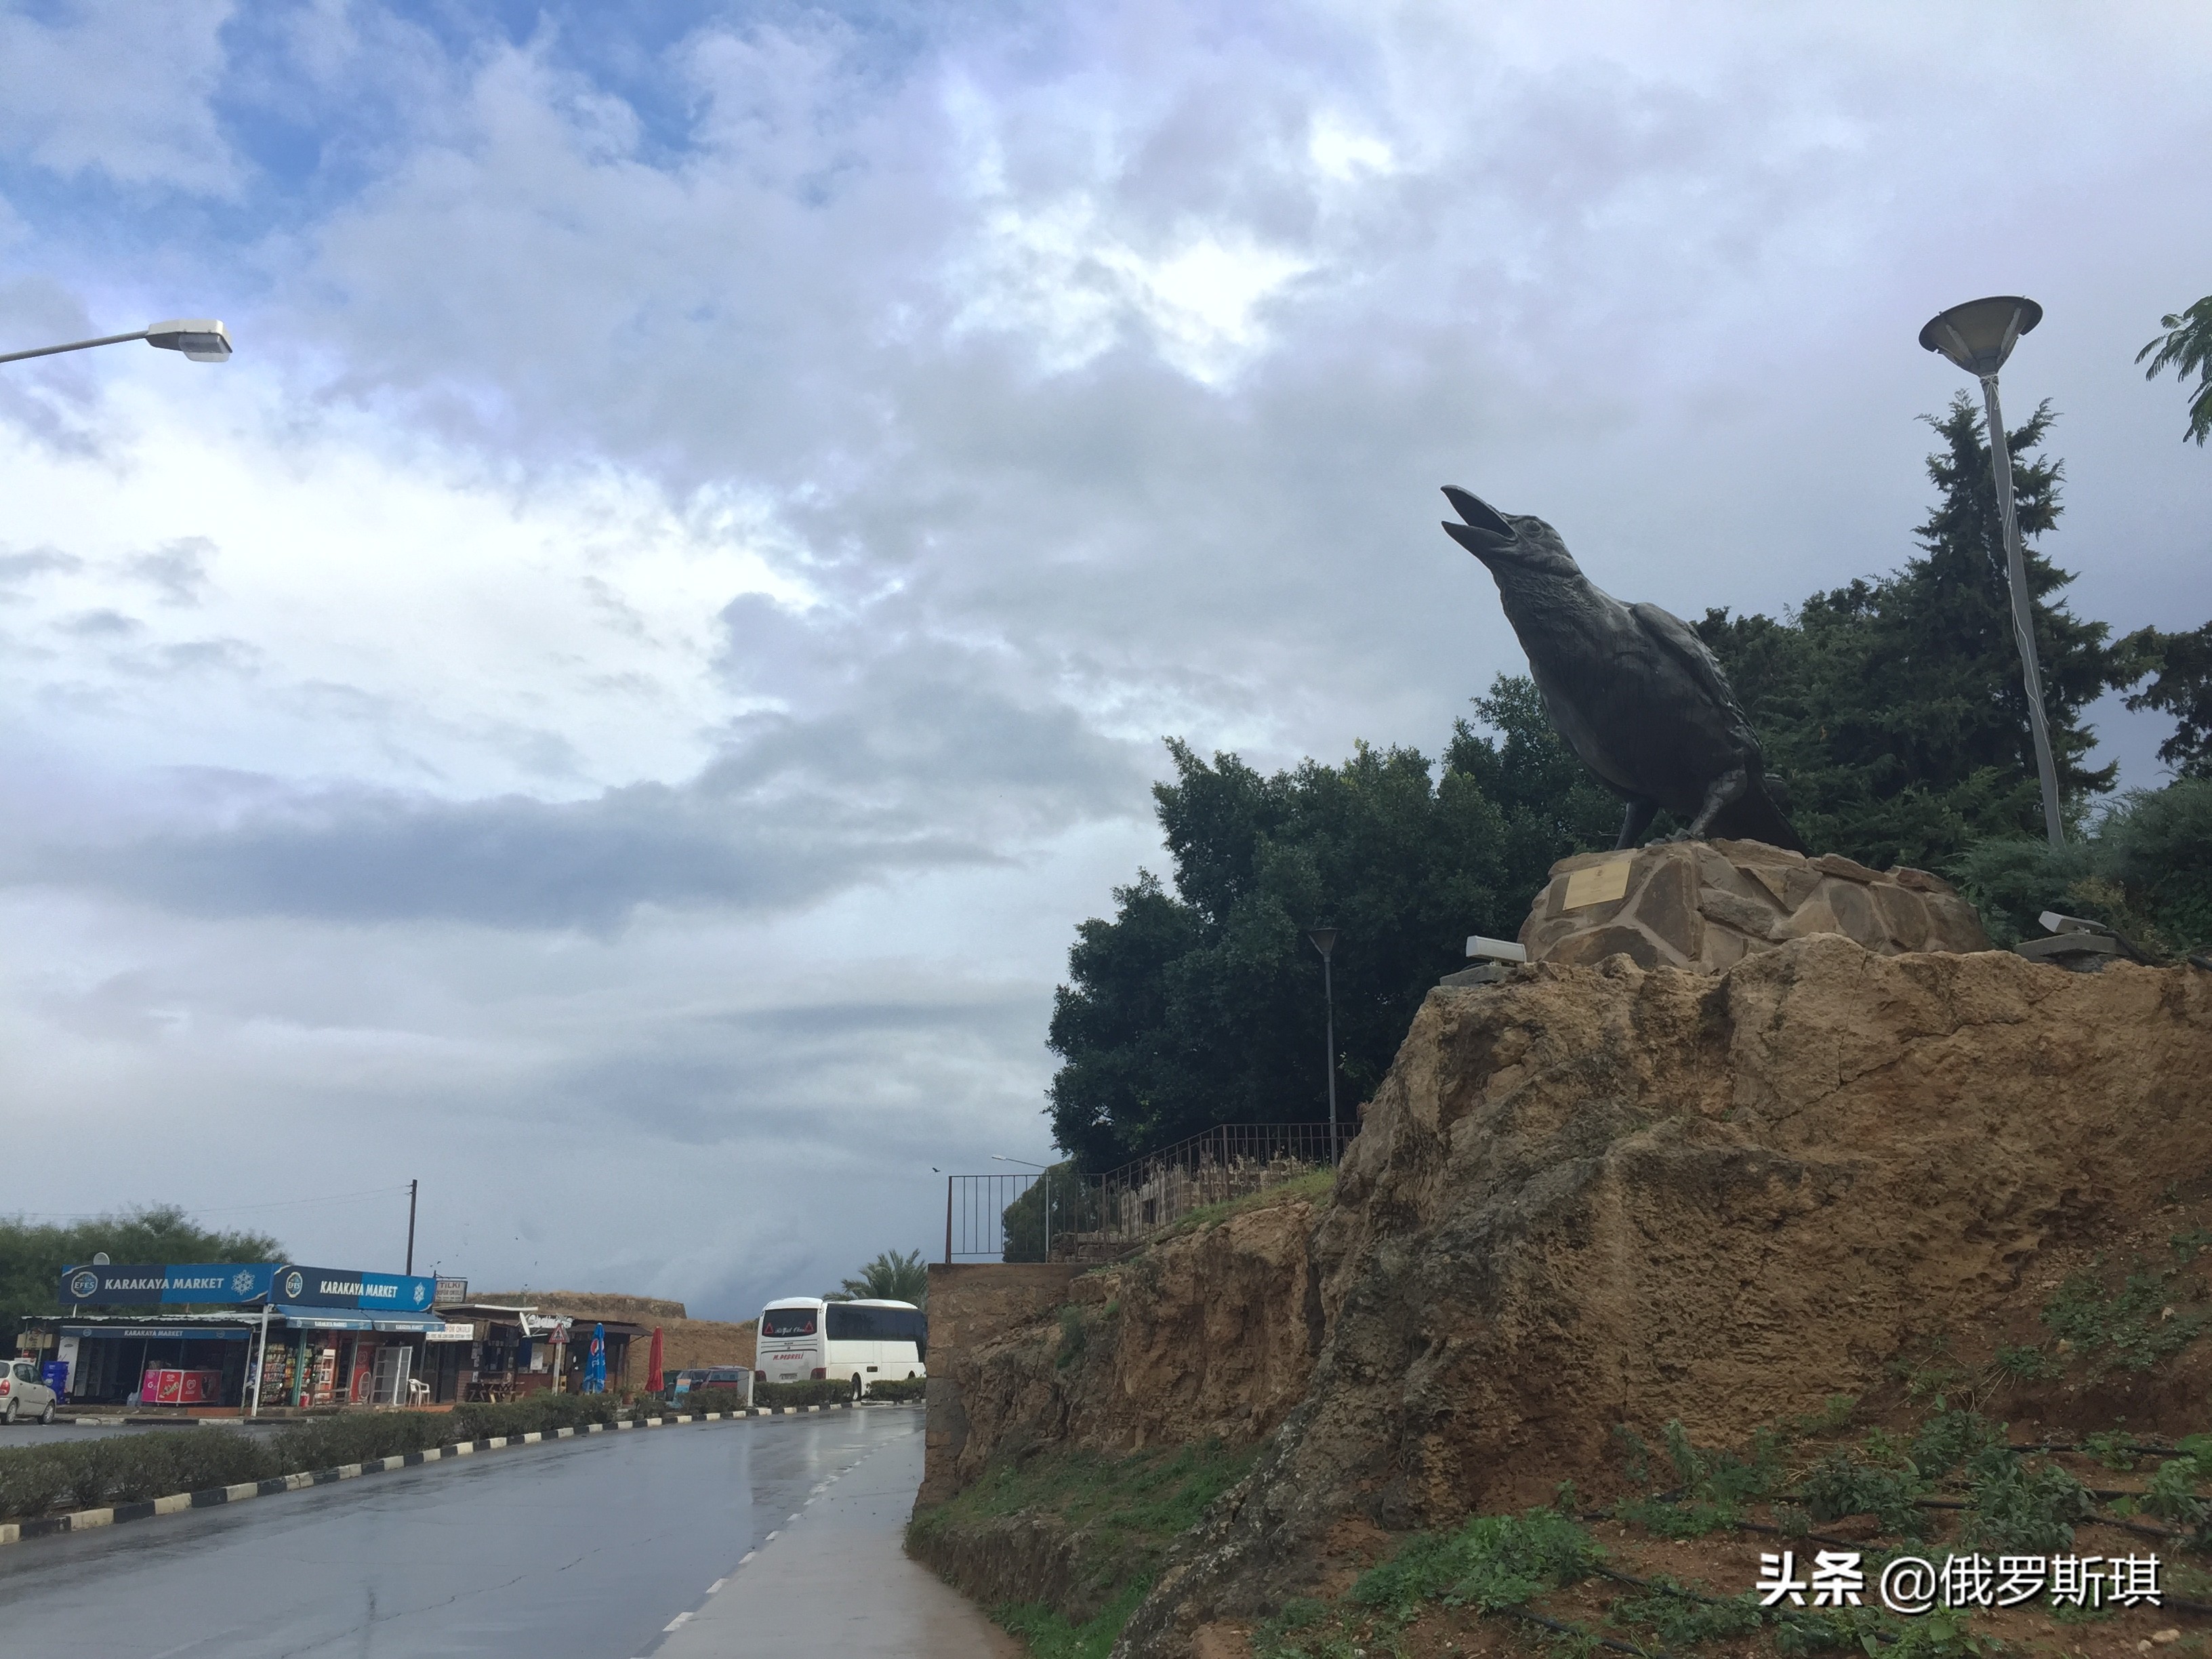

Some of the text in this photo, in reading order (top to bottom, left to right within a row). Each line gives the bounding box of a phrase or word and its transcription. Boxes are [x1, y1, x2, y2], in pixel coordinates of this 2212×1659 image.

[105, 1278, 224, 1289] KARAKAYA MARKET
[320, 1281, 398, 1298] KARAKAYA MARKET
